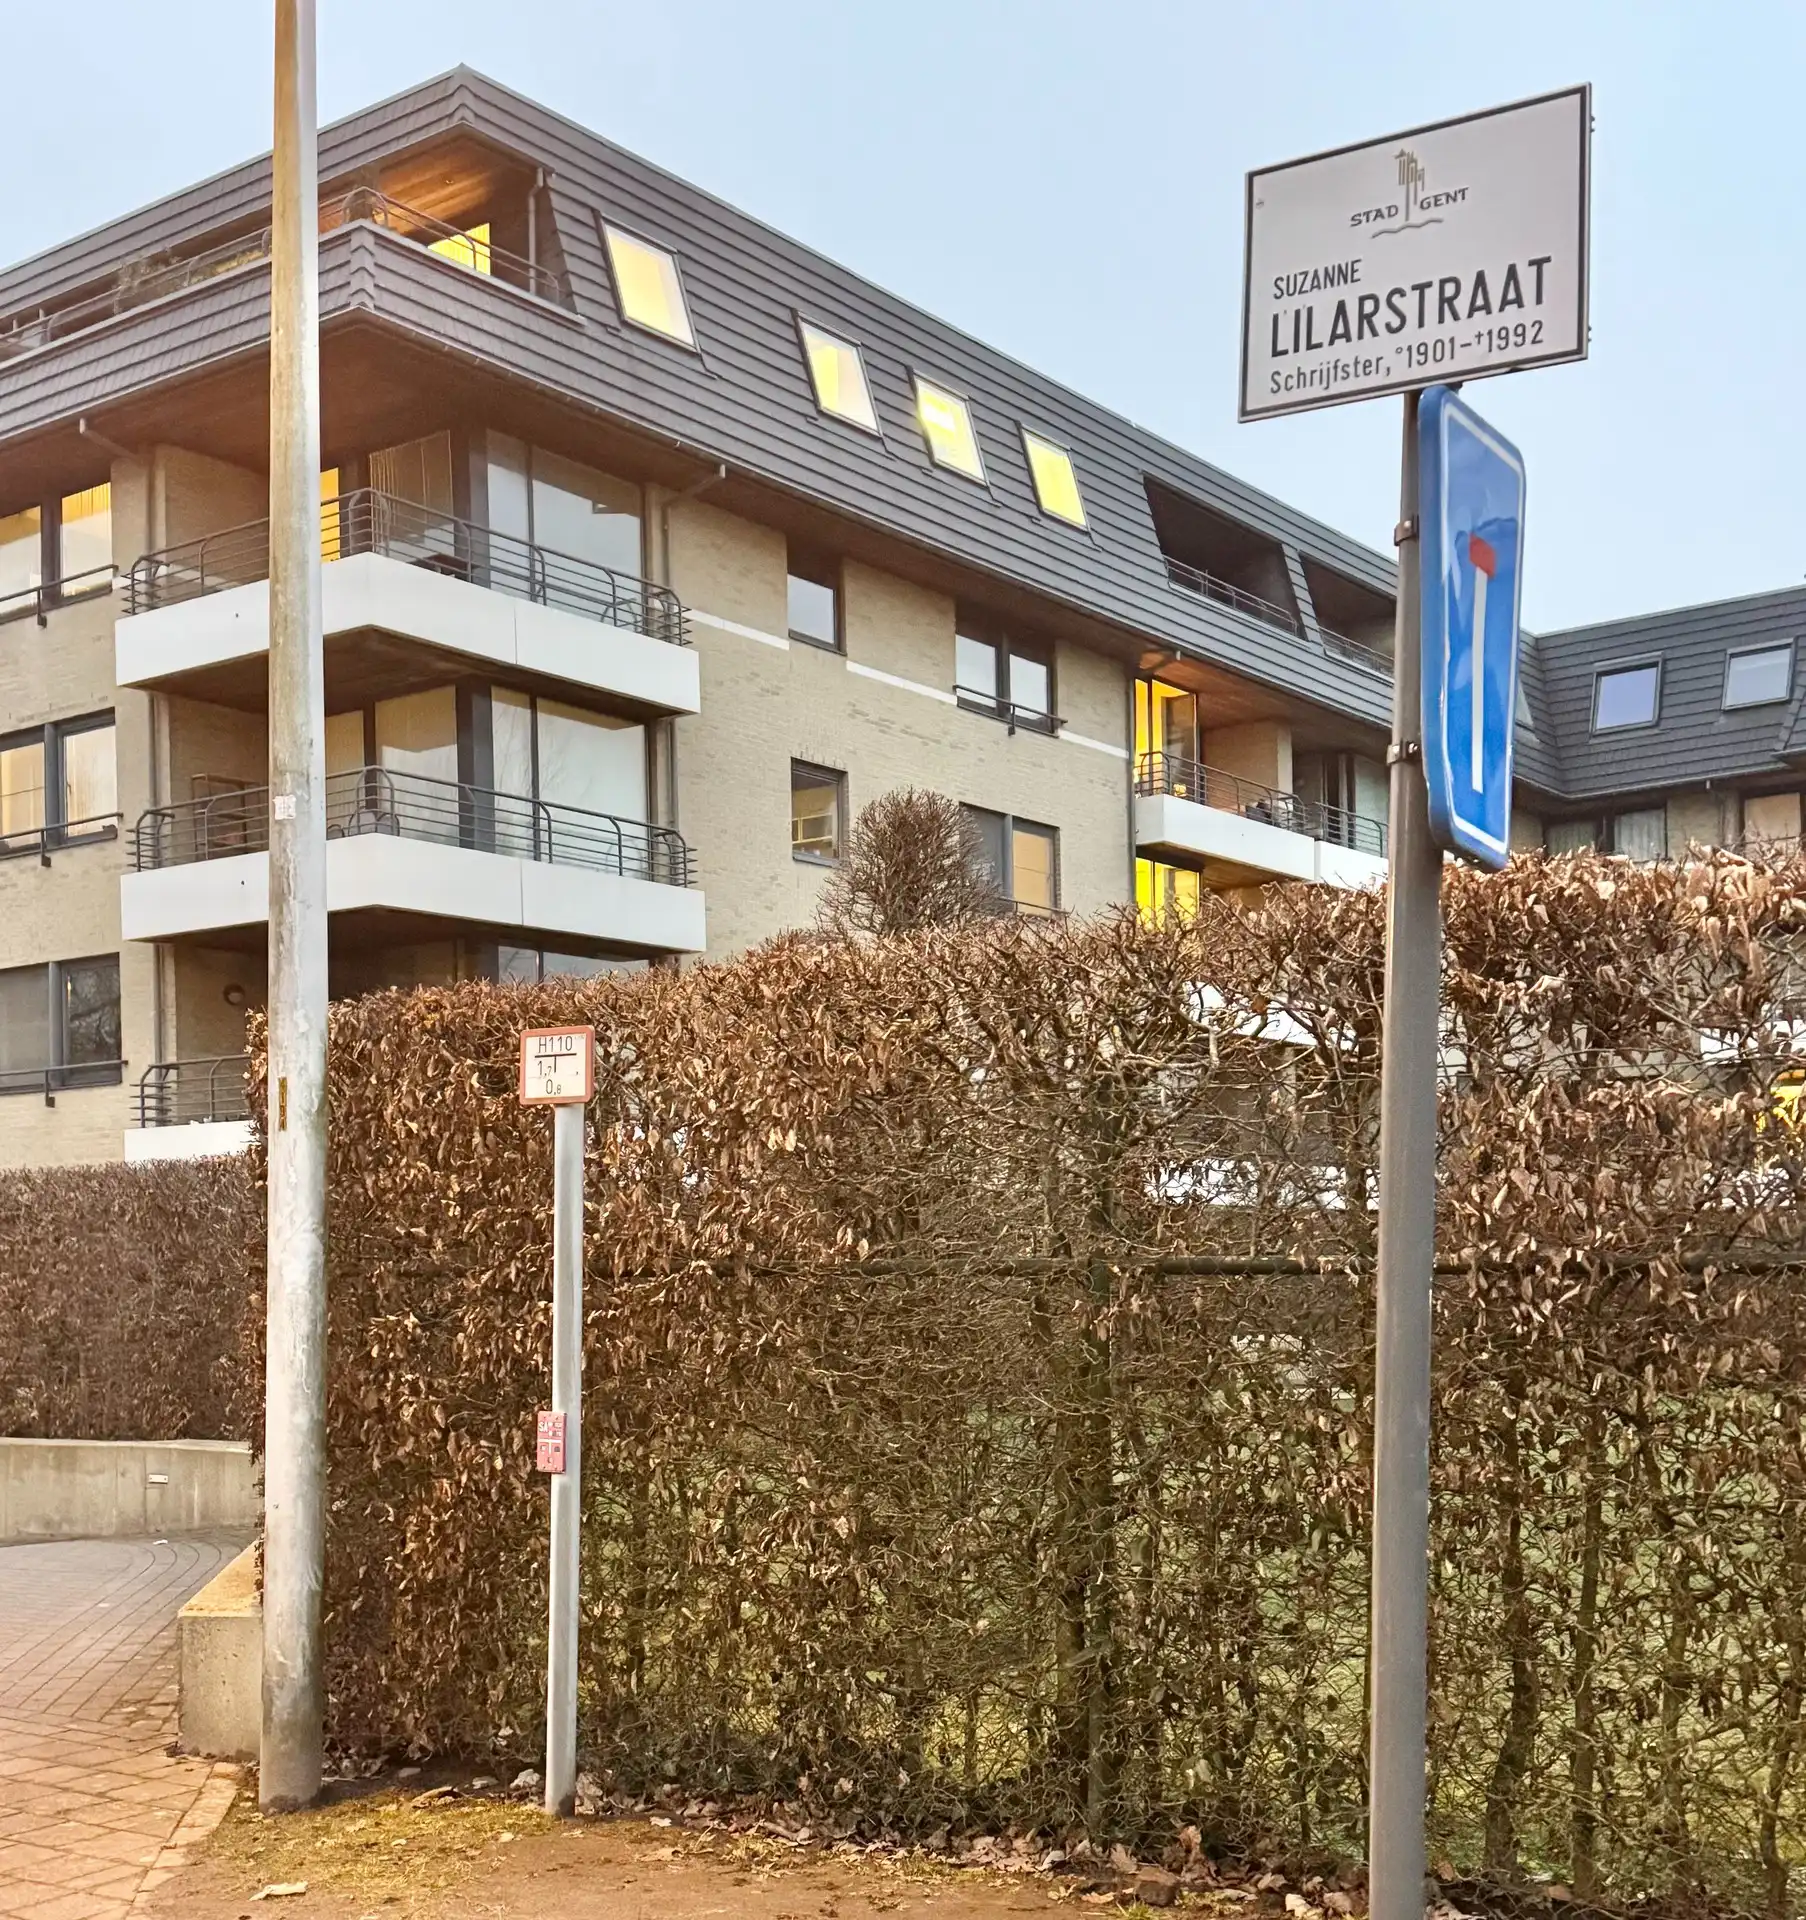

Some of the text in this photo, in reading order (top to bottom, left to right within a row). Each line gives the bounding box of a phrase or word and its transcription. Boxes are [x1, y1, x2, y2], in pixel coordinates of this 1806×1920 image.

[1349, 187, 1469, 227] STAD GENT
[1273, 259, 1362, 300] SUZANNE
[1271, 256, 1551, 358] LILARSTRAAT
[1270, 356, 1391, 395] Schrijfster,
[538, 1036, 573, 1053] H110
